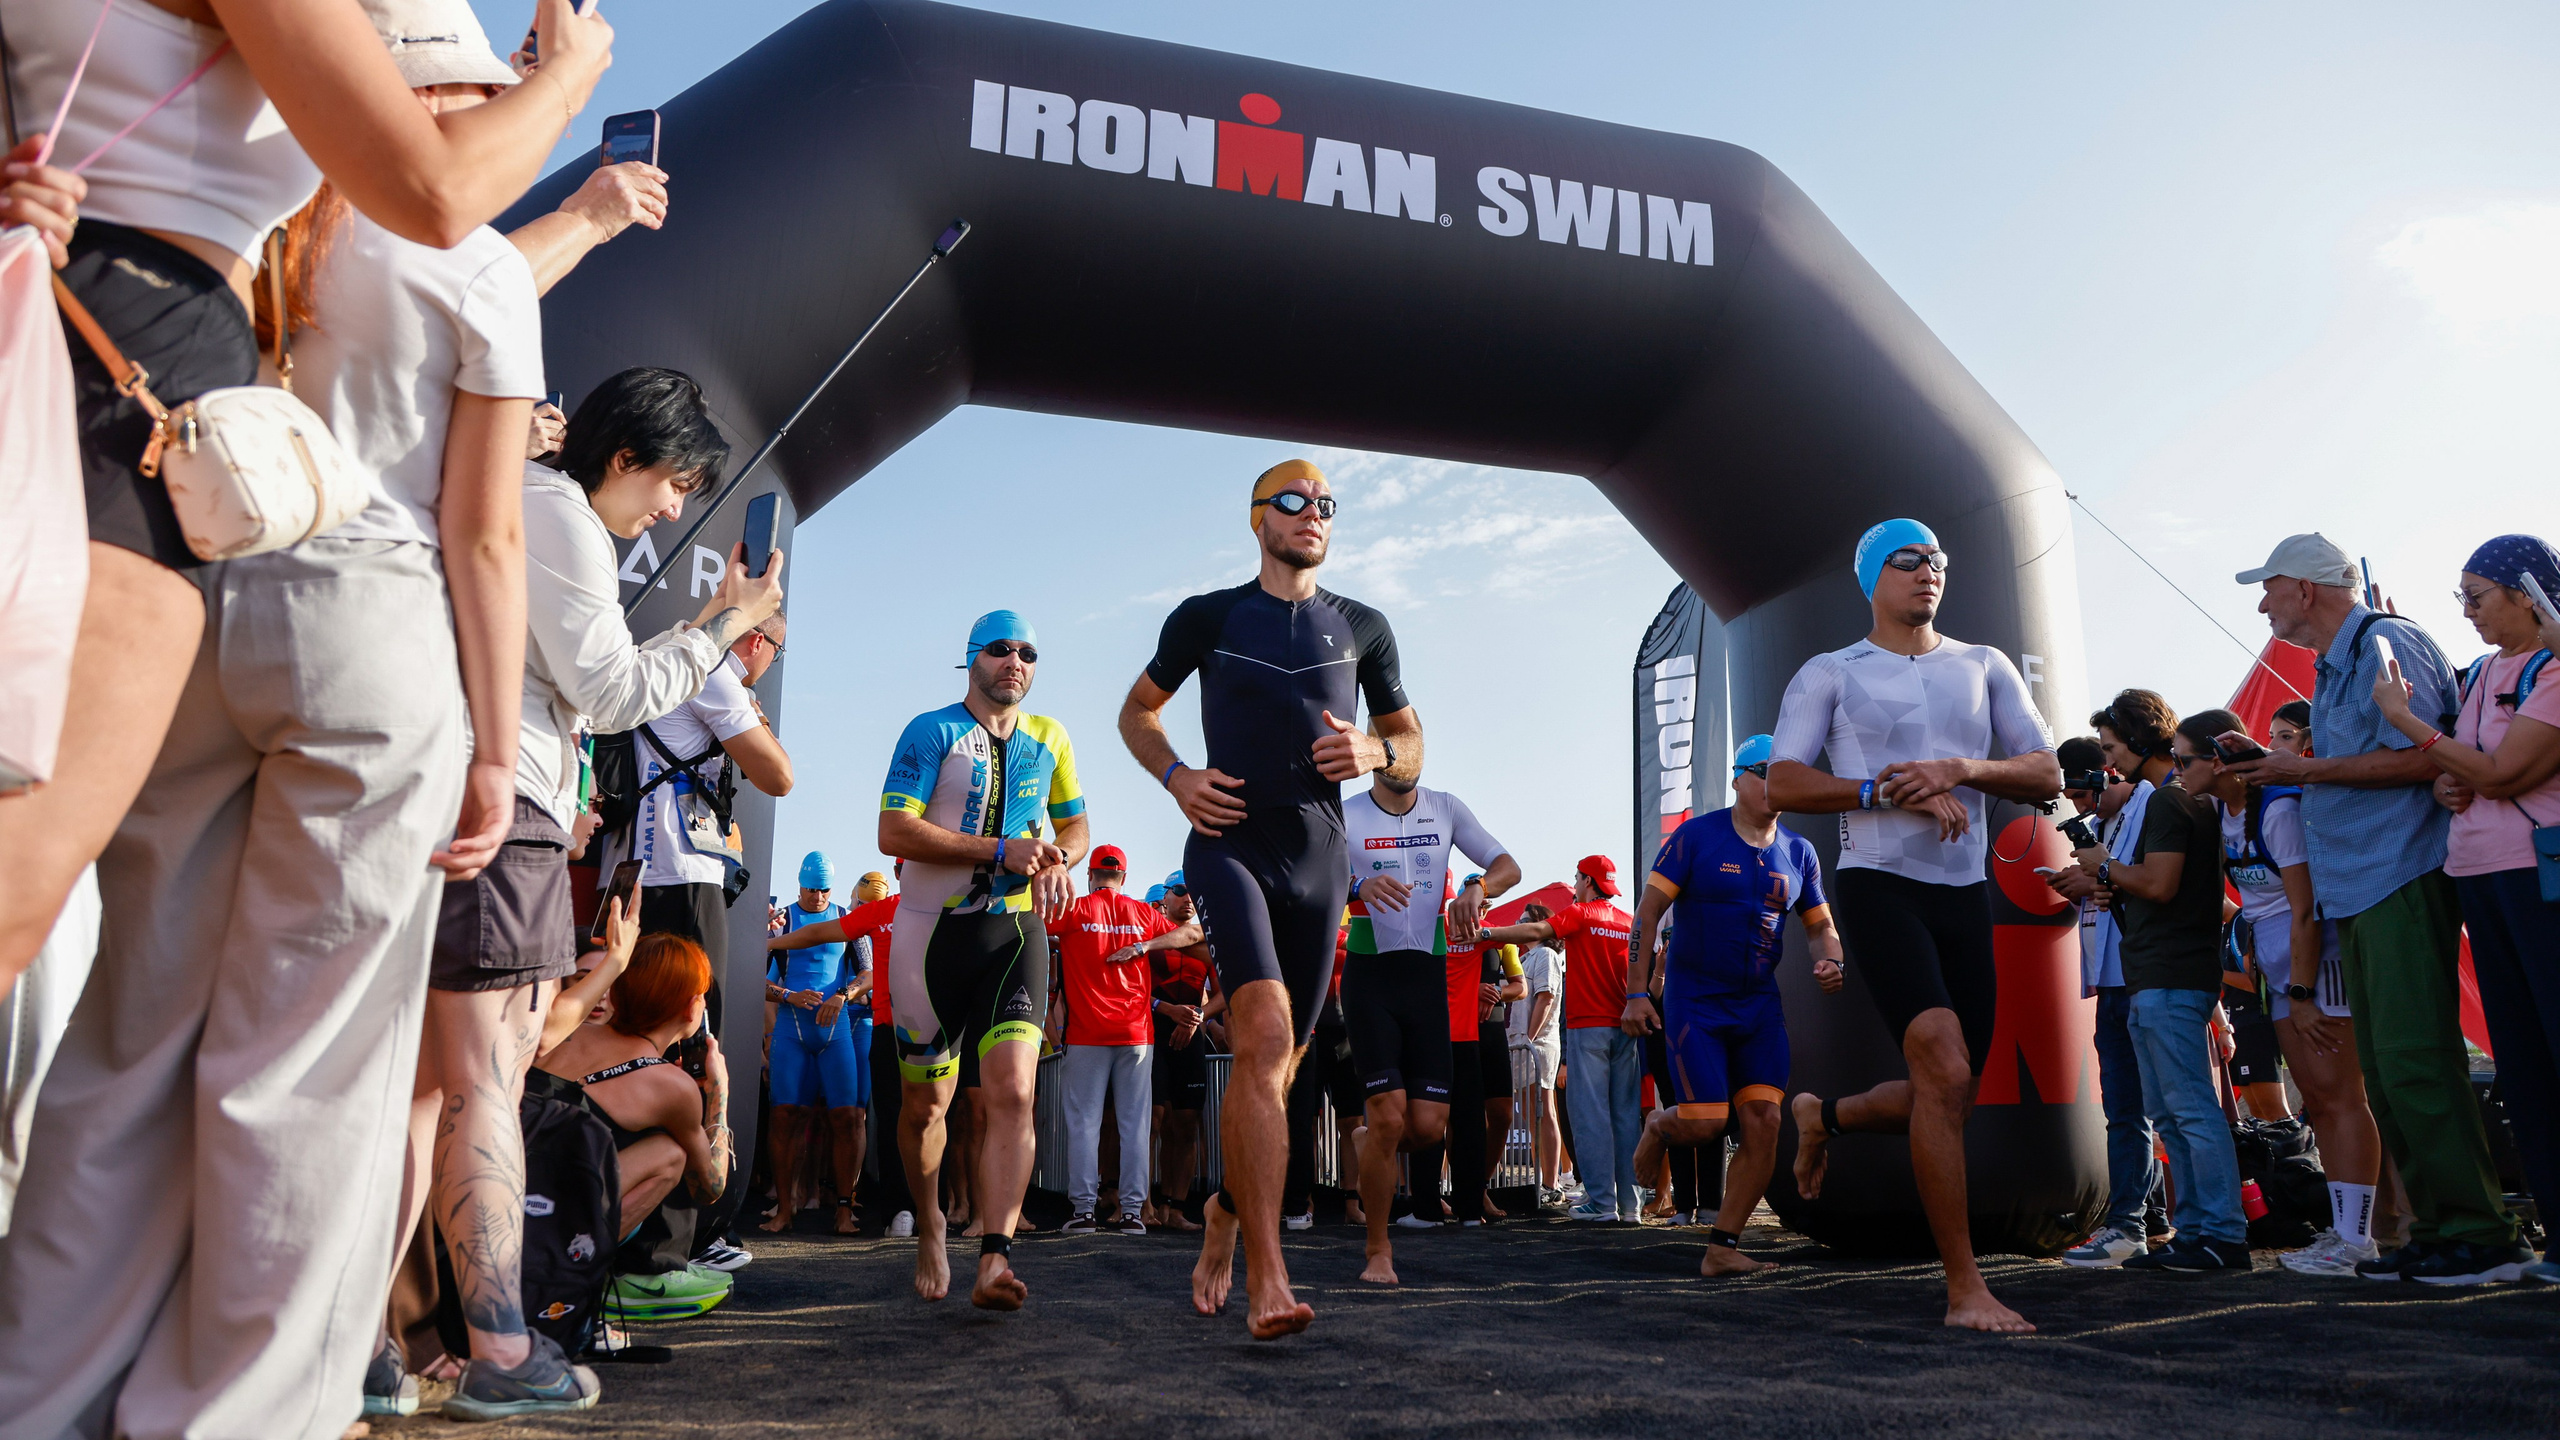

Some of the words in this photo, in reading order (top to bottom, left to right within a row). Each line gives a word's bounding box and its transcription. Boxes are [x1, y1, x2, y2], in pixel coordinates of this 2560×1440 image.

[1477, 166, 1714, 267] SWIM
[1845, 650, 1874, 662] FUSION
[991, 746, 1000, 771] Club
[1019, 778, 1039, 787] ALIYEV
[646, 761, 660, 822] LEAER
[990, 773, 1000, 806] Sport
[1018, 786, 1038, 798] KAZ
[1377, 836, 1439, 847] TRITERRA
[2233, 866, 2266, 881] BAKU
[1414, 881, 1432, 889] FMG
[1082, 923, 1144, 936] VOLUNTEER
[1629, 930, 1641, 963] 803
[602, 1062, 632, 1078] PINK
[926, 1066, 950, 1079] KZ
[526, 1200, 548, 1210] PUMA
